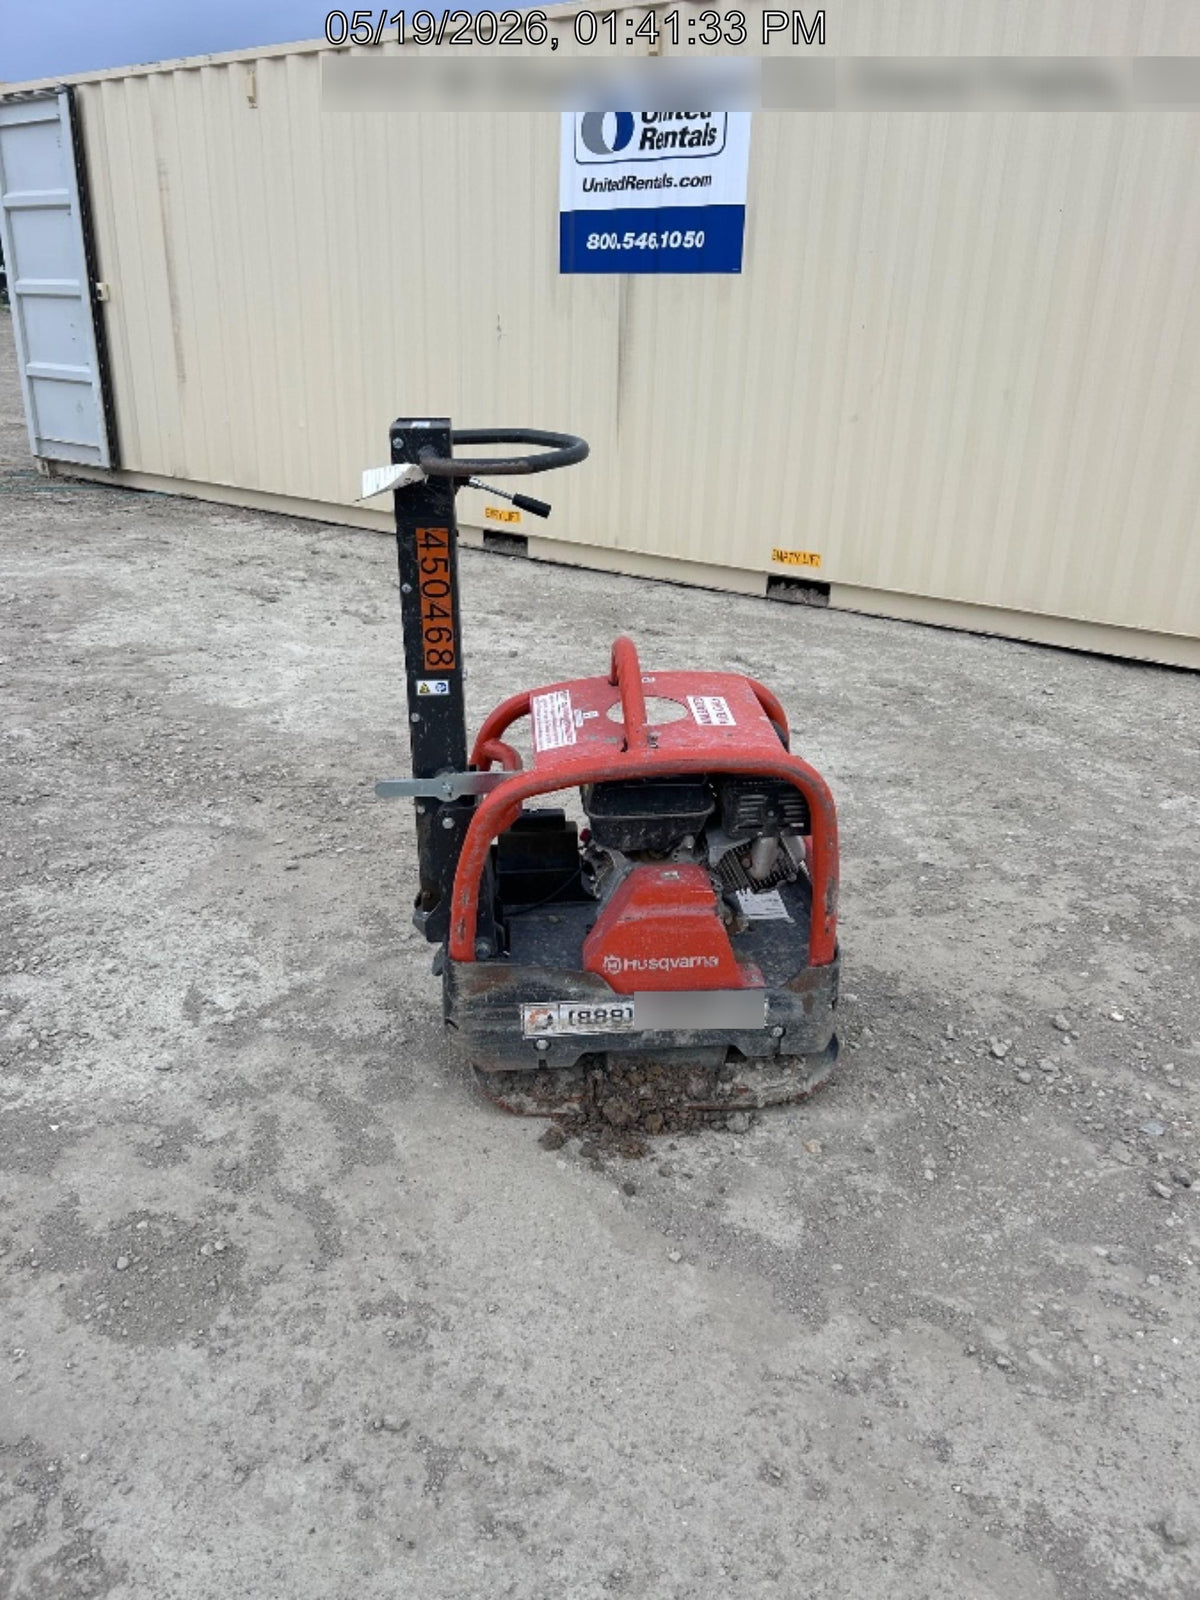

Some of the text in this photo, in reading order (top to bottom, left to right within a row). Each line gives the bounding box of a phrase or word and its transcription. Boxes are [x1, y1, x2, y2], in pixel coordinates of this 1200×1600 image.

[638, 122, 717, 150] Rentals
[582, 173, 712, 193] UnitedRentals.com
[586, 230, 705, 250] 800.546.1050
[419, 532, 455, 666] 450468
[623, 955, 720, 972] Husqvarna
